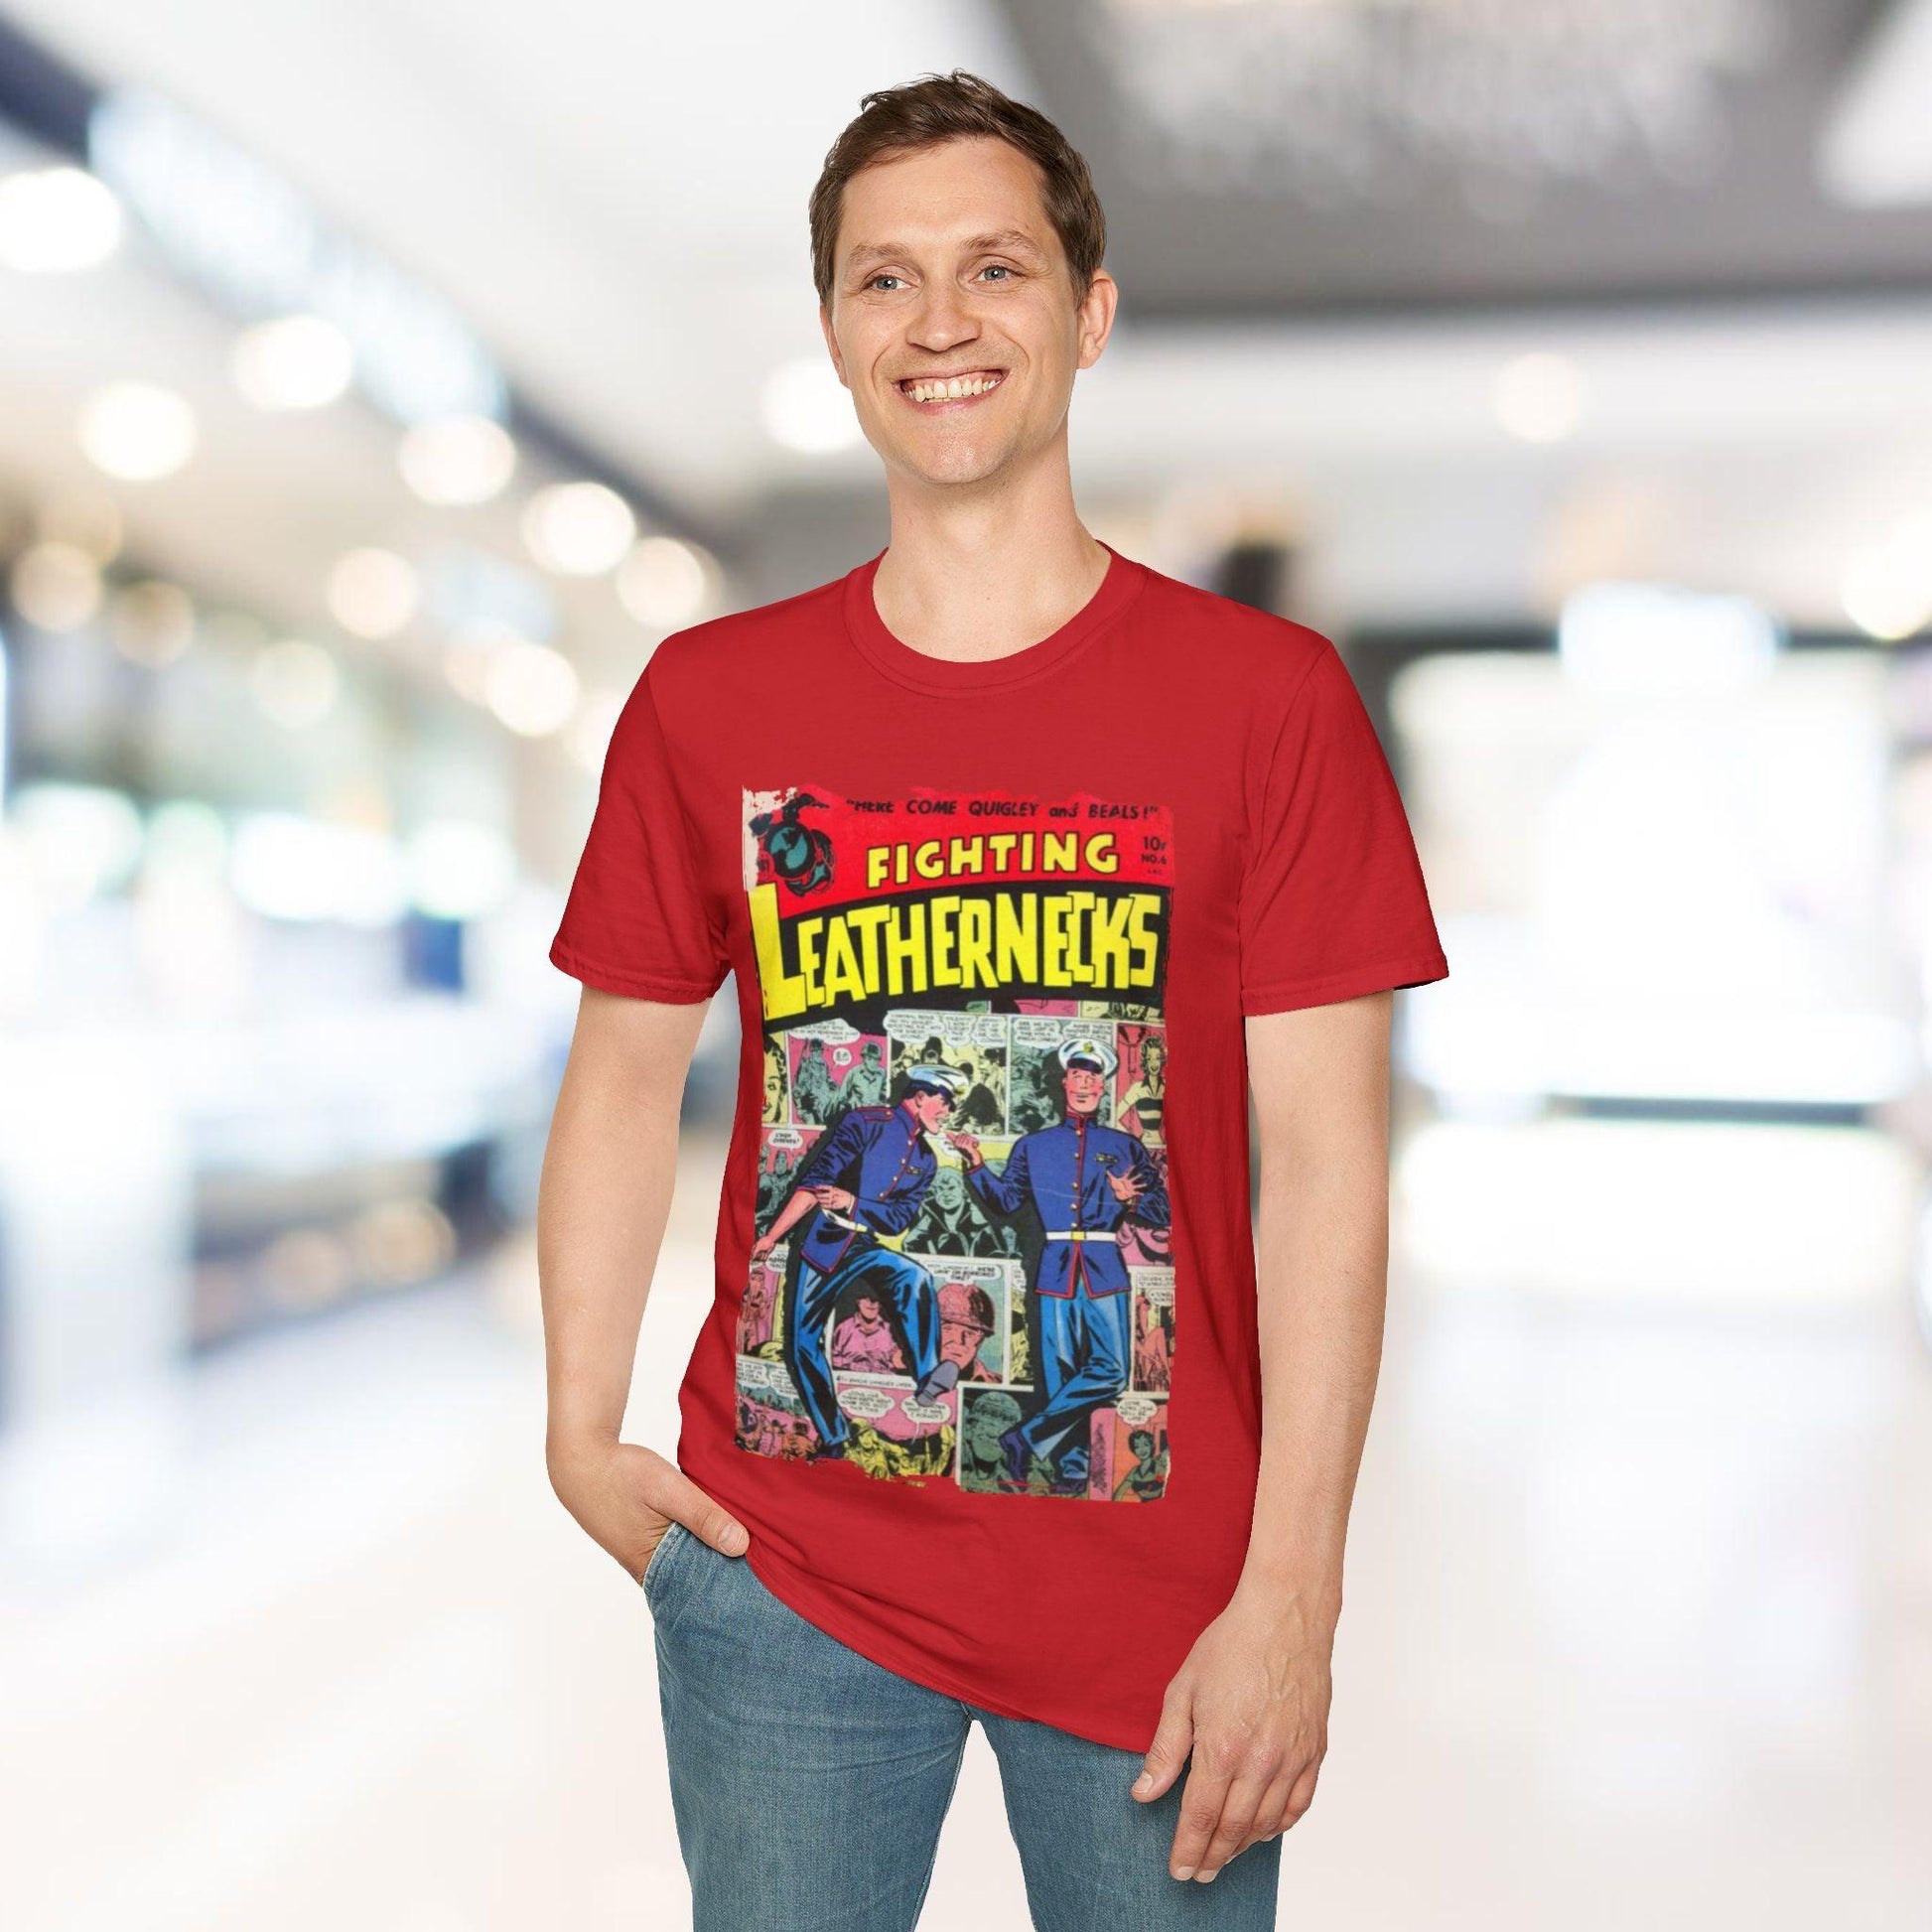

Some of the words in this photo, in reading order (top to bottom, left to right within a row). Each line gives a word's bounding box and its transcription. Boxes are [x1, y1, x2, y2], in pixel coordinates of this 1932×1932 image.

[906, 799, 958, 815] COME
[968, 799, 1039, 817] QUIGLEY
[1048, 802, 1079, 818] and
[866, 831, 1120, 890] FIGHTING
[748, 882, 1162, 1022] LEATHERNECKS
